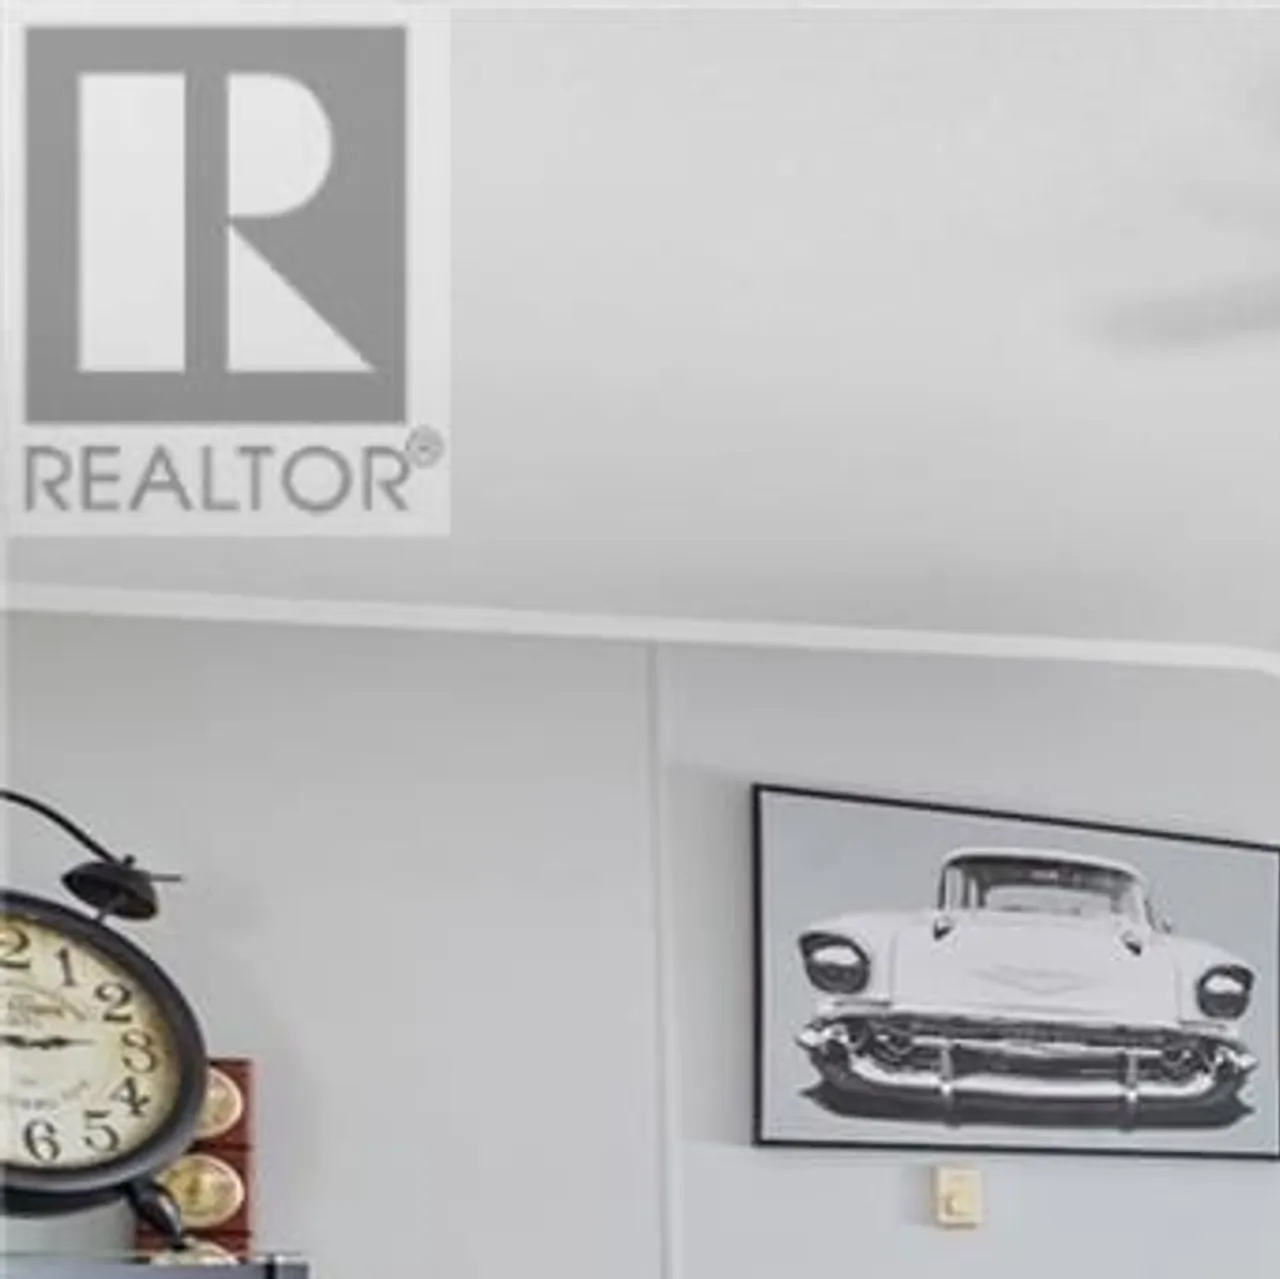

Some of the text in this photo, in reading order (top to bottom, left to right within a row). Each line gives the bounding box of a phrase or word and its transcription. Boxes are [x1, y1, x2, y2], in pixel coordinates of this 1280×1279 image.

[0, 925, 30, 969] 2
[54, 946, 76, 989] 1
[94, 982, 133, 1023] 2
[121, 1029, 158, 1075] 3
[110, 1076, 151, 1118] 4
[24, 1119, 61, 1162] 6
[83, 1109, 119, 1153] 5
